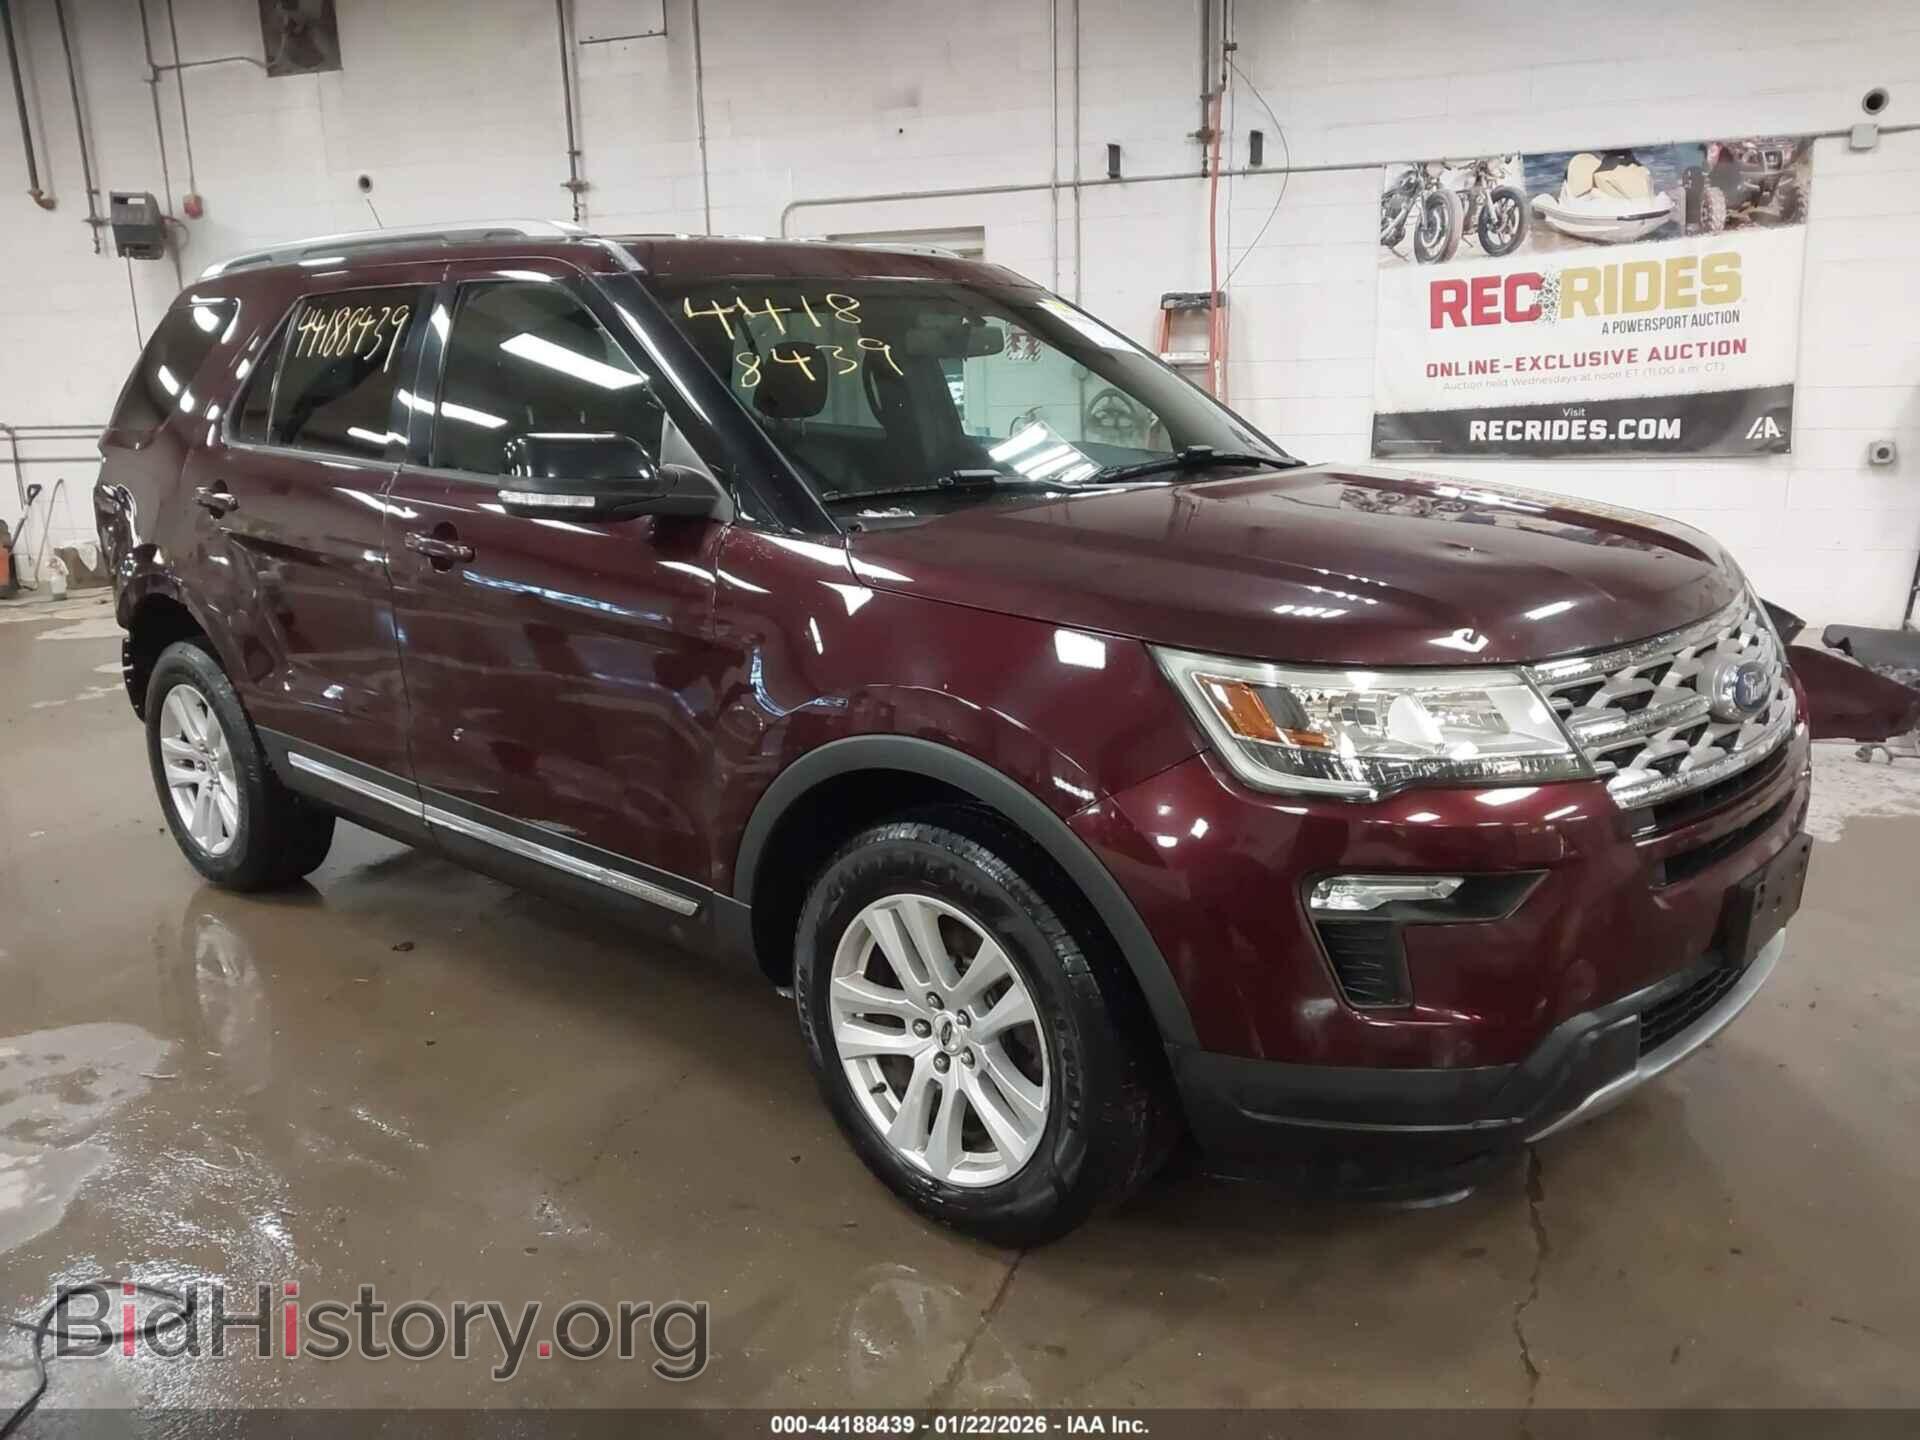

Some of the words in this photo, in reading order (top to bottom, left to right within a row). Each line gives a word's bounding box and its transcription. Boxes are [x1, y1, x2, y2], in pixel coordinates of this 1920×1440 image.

[1430, 271, 1543, 330] REC
[1559, 250, 1743, 321] RIDES
[683, 293, 862, 340] 4418
[1602, 321, 1610, 335] A
[1612, 315, 1688, 334] POWERSPORT
[1690, 309, 1741, 327] AUCTION
[295, 304, 409, 374] 44188439
[1426, 348, 1639, 379] ONLINE-EXCLUSIVE
[1647, 337, 1748, 362] AUCTION
[736, 337, 905, 388] 8439
[1442, 380, 1482, 391] Auction
[1511, 373, 1578, 387] Wednesdays
[1469, 418, 1681, 441] RECRIDES.COM
[1562, 407, 1586, 417] Visit
